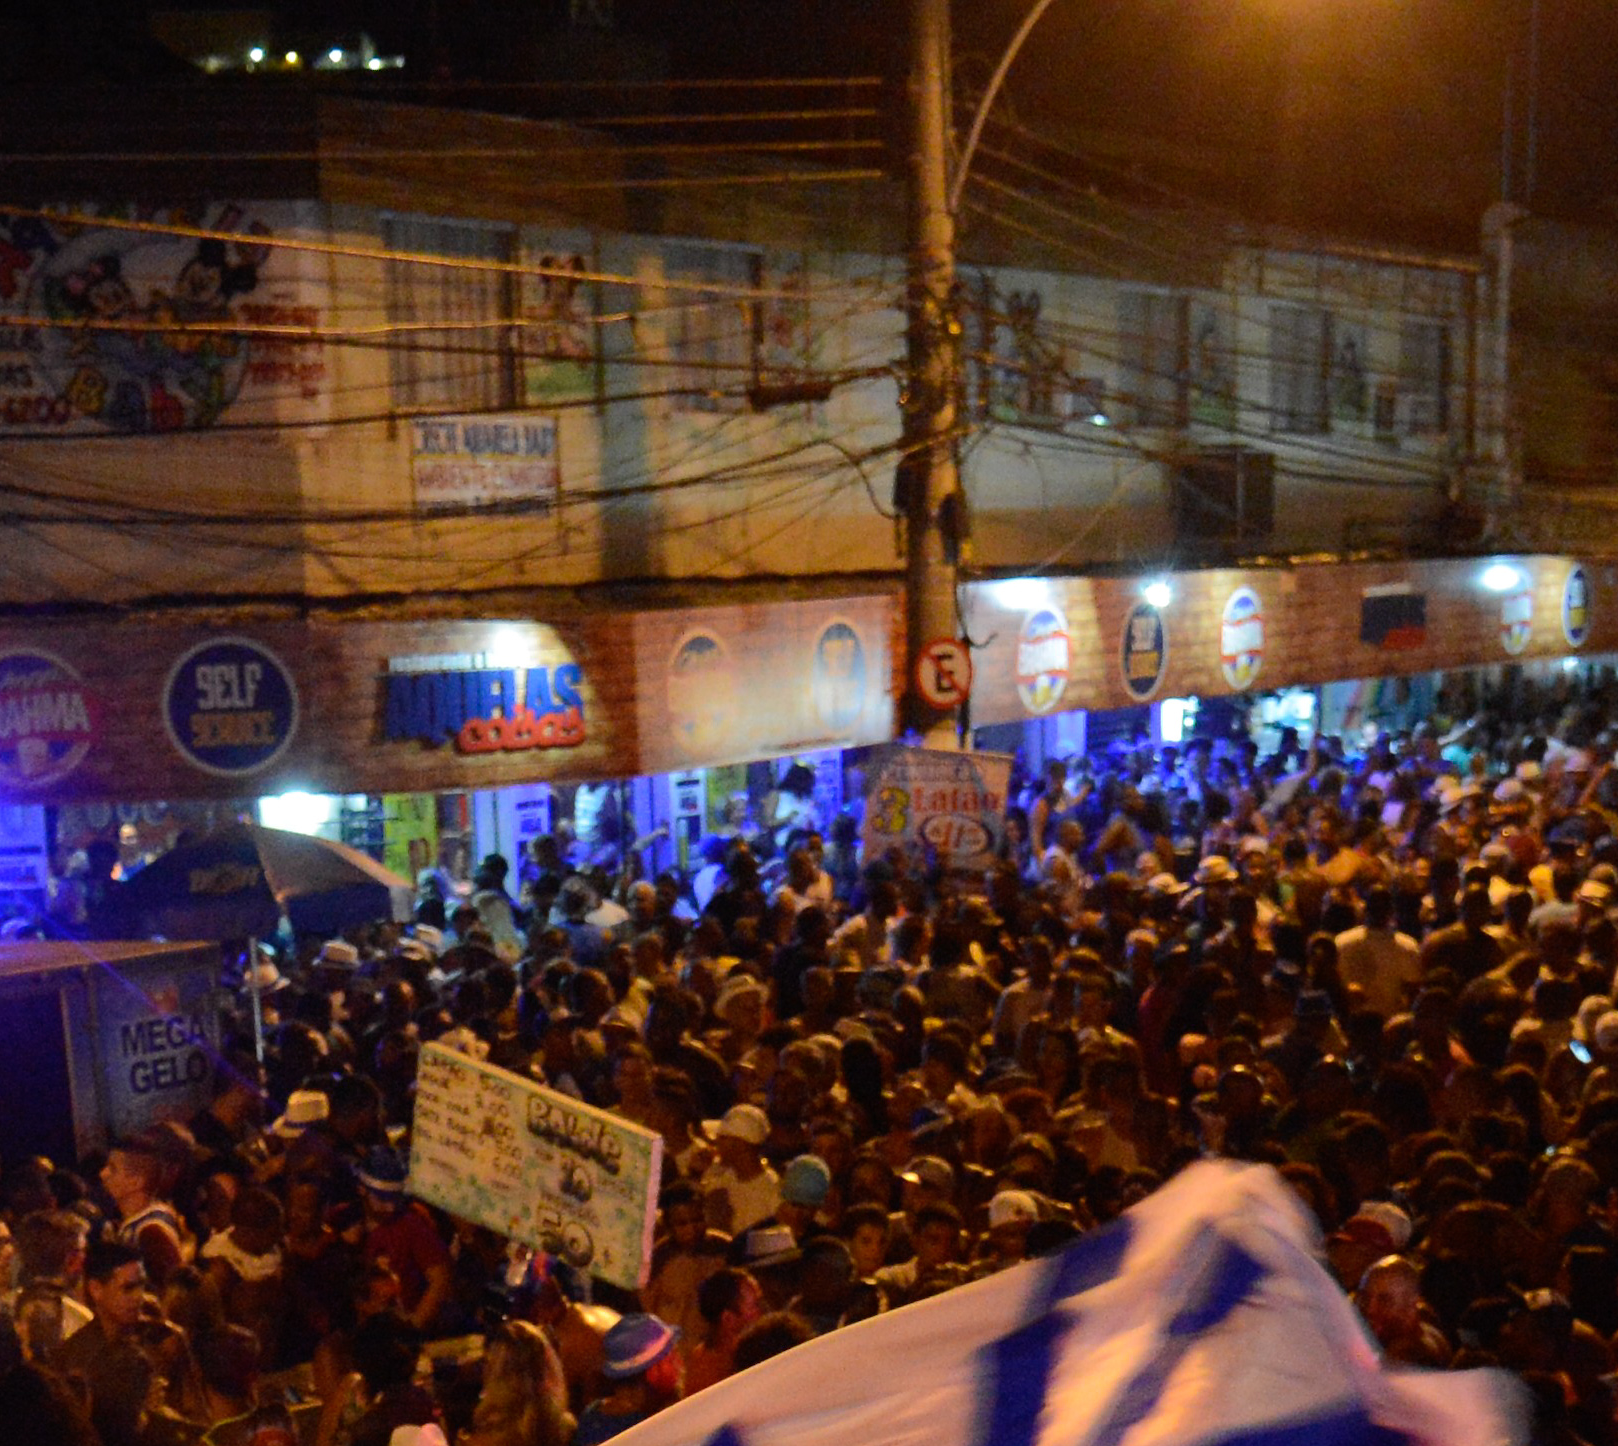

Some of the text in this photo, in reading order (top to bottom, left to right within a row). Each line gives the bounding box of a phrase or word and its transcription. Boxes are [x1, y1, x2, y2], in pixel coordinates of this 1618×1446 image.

[195, 662, 262, 710] SELF
[935, 652, 954, 692] E
[123, 1016, 206, 1057] MEGA
[131, 1048, 206, 1093] GELO
